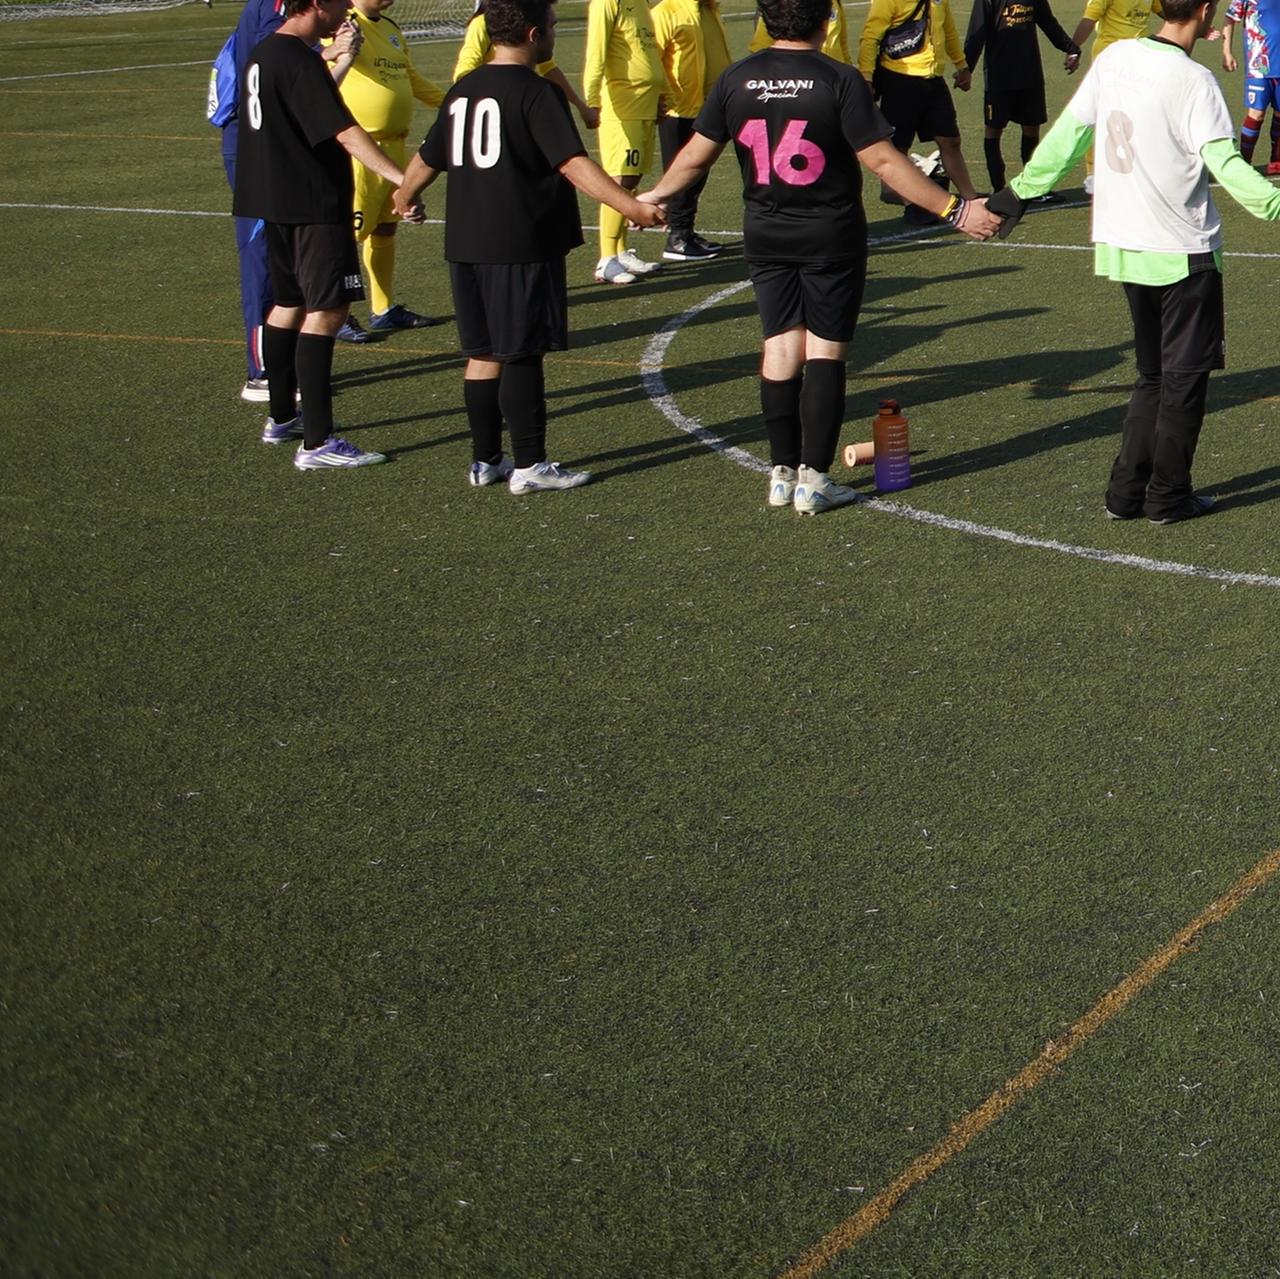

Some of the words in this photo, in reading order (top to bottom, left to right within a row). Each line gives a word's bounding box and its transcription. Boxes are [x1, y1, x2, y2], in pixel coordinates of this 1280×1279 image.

[248, 63, 262, 130] 8
[746, 80, 814, 90] GALVANI
[757, 87, 799, 103] Special
[449, 97, 501, 169] 10
[625, 149, 639, 166] 10
[738, 119, 826, 186] 16
[1105, 110, 1134, 174] 8
